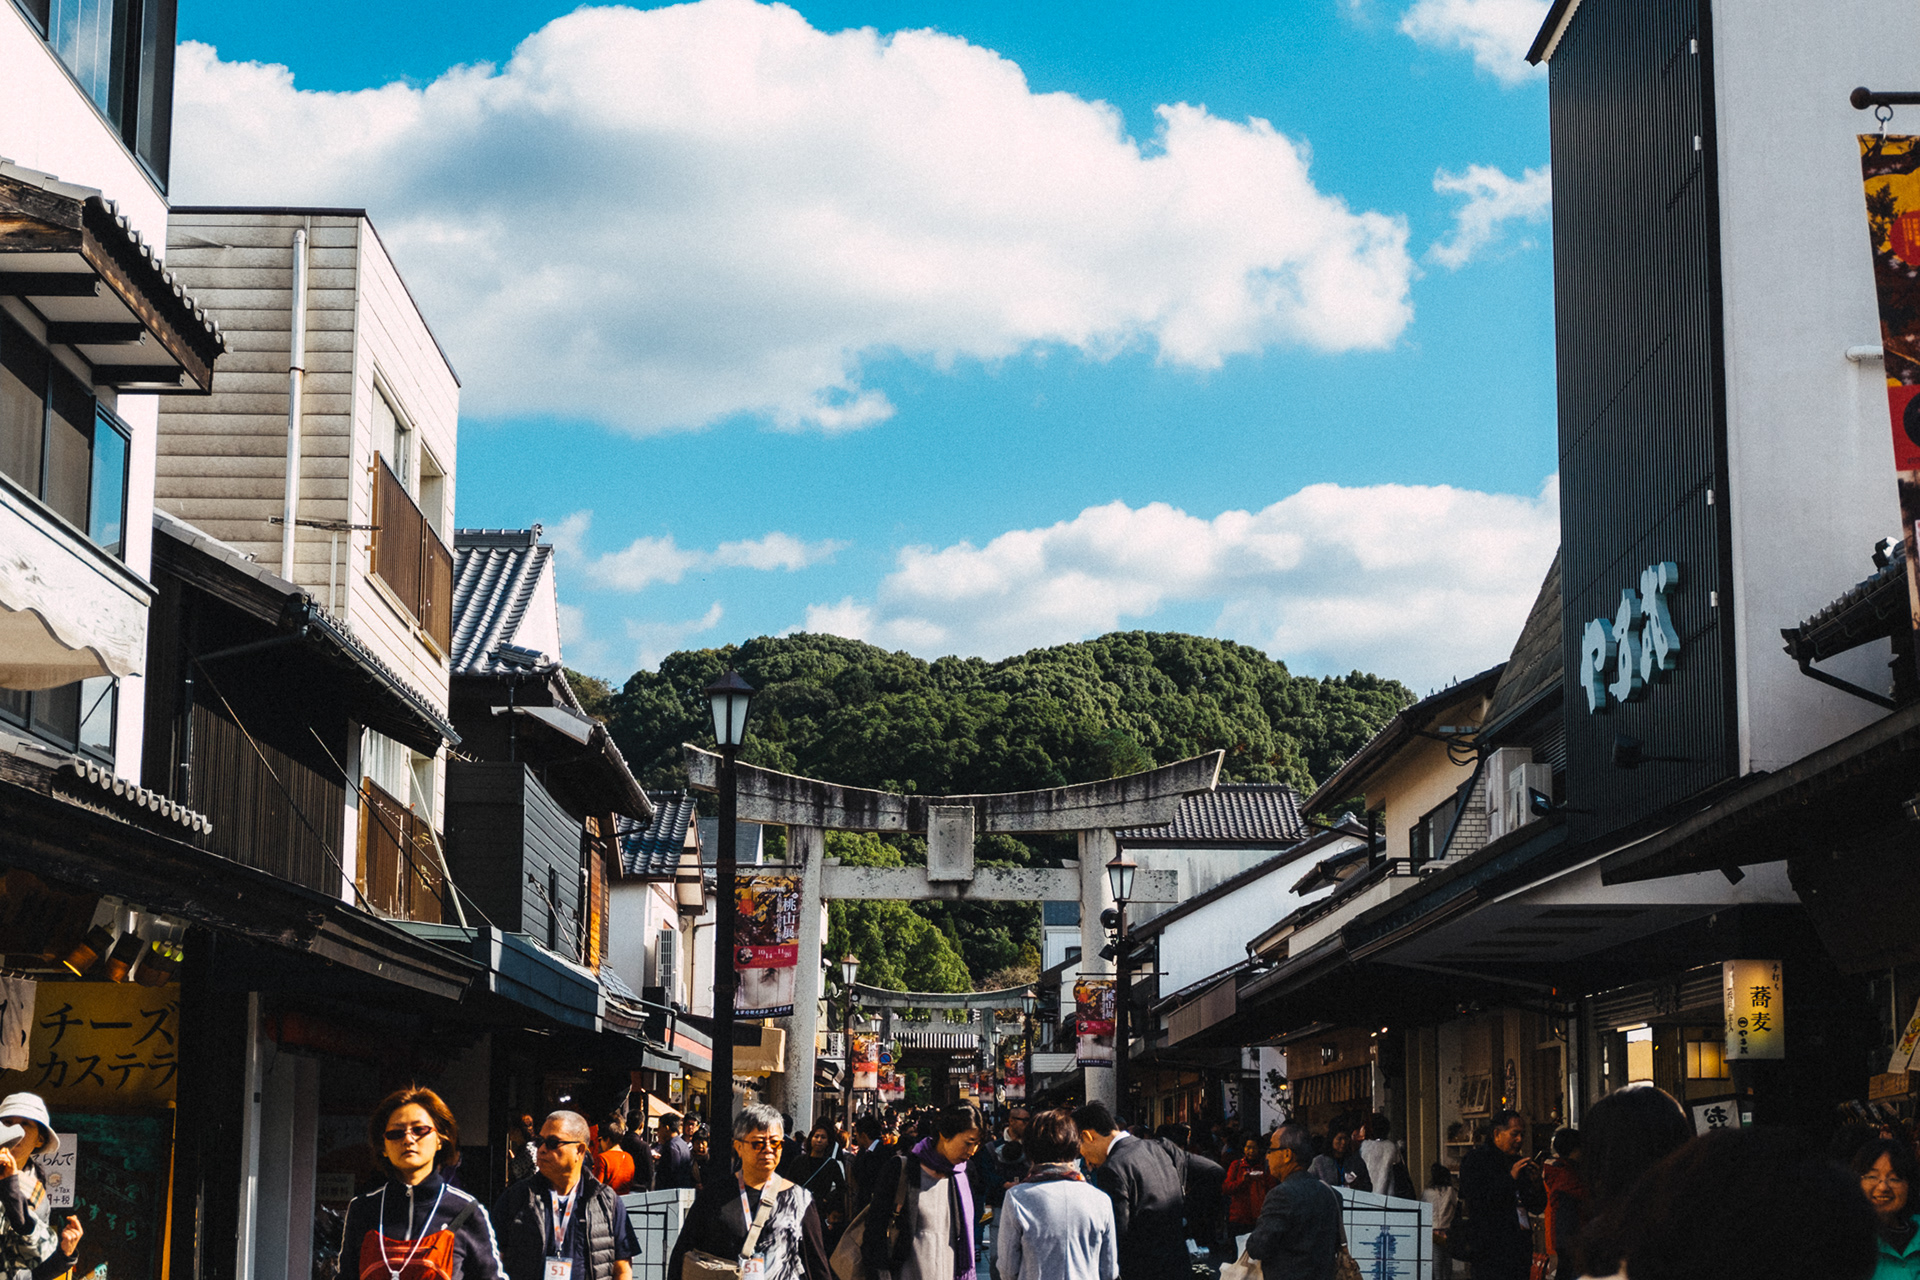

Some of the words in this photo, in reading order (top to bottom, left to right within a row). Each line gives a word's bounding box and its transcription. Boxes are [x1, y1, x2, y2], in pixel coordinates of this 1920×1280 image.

[783, 898, 796, 938] 桃山展
[40, 1001, 180, 1048] チーズ
[1750, 986, 1772, 1032] 蕎麦
[34, 1051, 178, 1090] カステラ
[551, 1265, 565, 1276] 51
[744, 1262, 759, 1274] 51
